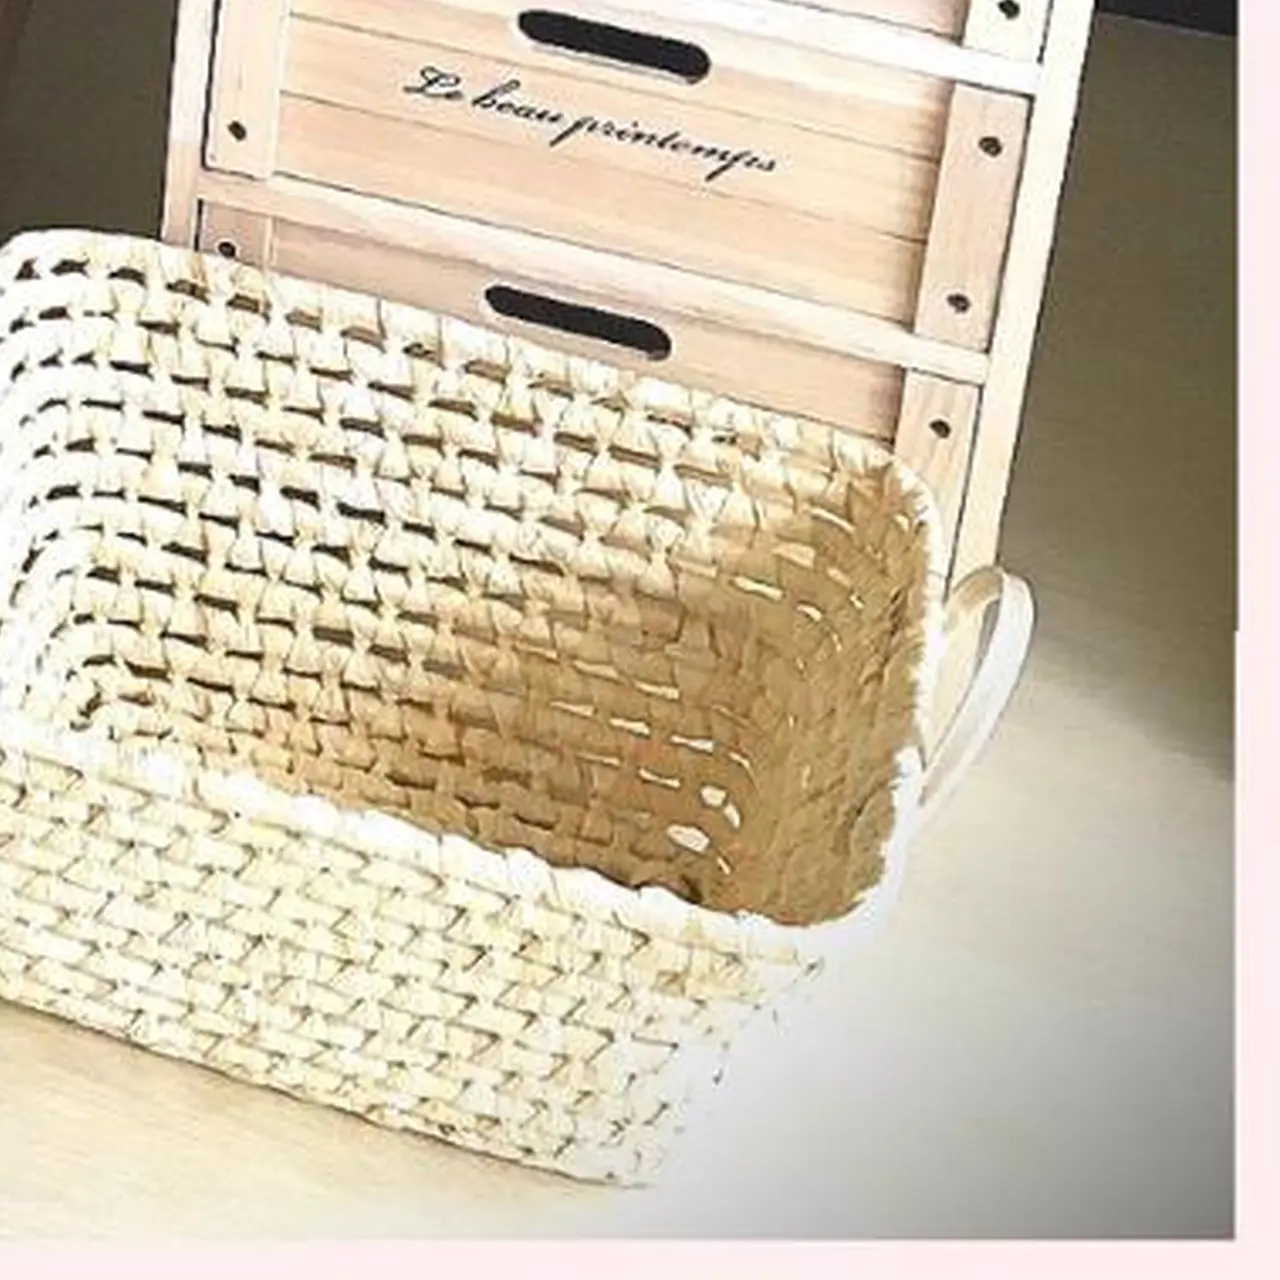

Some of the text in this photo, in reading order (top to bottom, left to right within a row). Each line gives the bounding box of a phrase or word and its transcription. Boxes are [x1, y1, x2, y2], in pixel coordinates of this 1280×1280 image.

[403, 65, 778, 183] Le beau printemps
